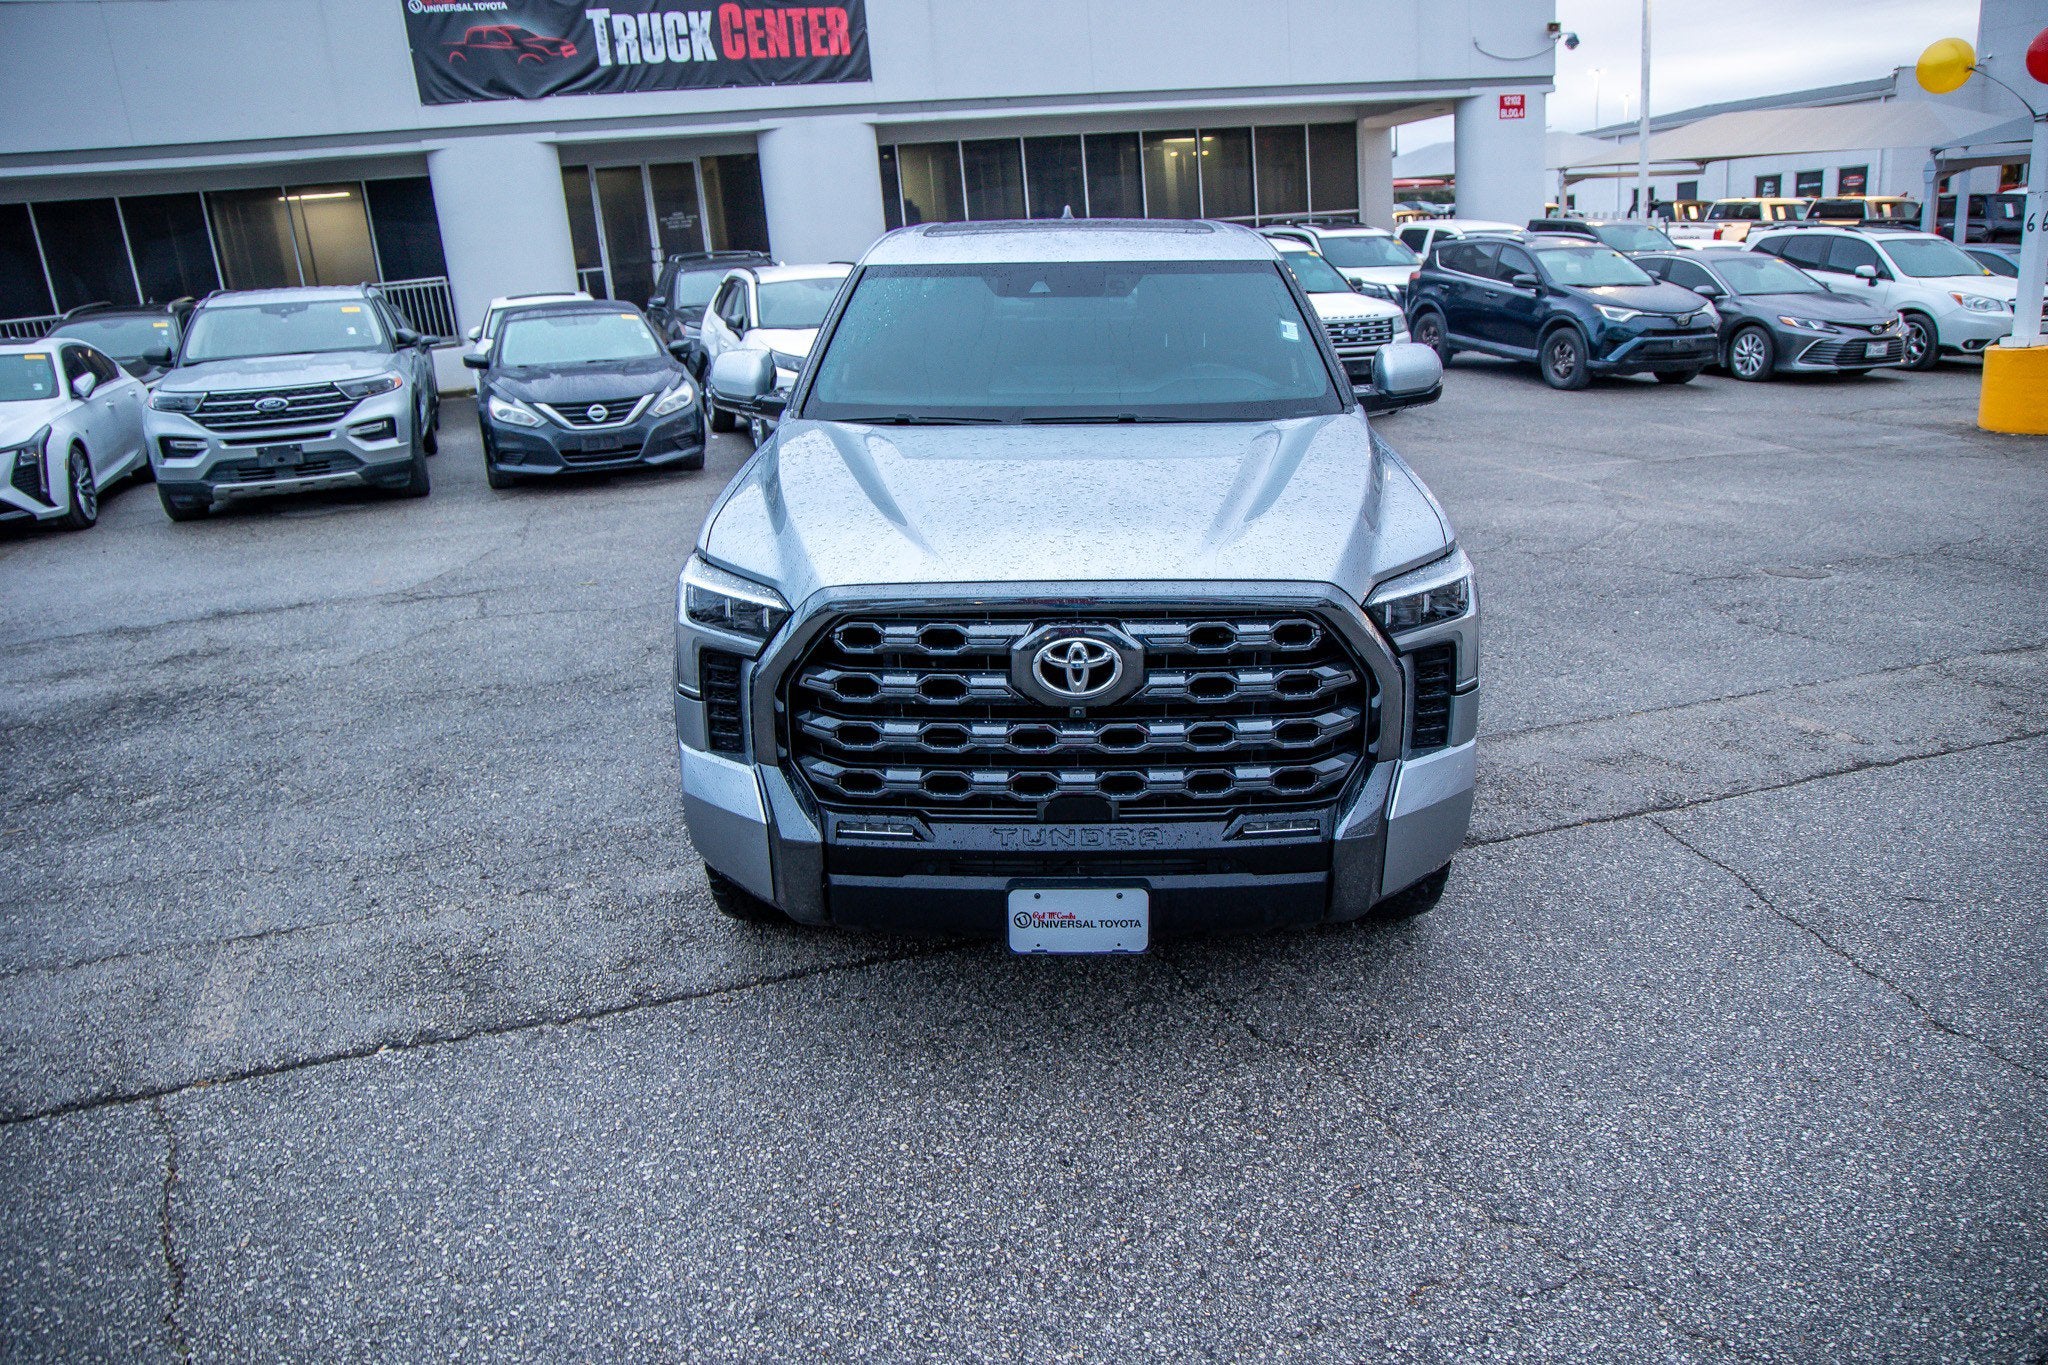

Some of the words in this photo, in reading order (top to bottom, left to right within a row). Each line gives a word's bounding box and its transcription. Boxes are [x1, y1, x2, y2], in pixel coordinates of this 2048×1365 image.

[423, 4, 474, 13] UNIVERSAL
[473, 2, 507, 11] TOYOTA
[585, 8, 718, 67] TRUCK
[718, 2, 851, 60] CENTER
[993, 827, 1164, 847] TUNDRA
[1032, 919, 1097, 929] UNIVERSAL
[1099, 919, 1142, 928] TOYOTA
